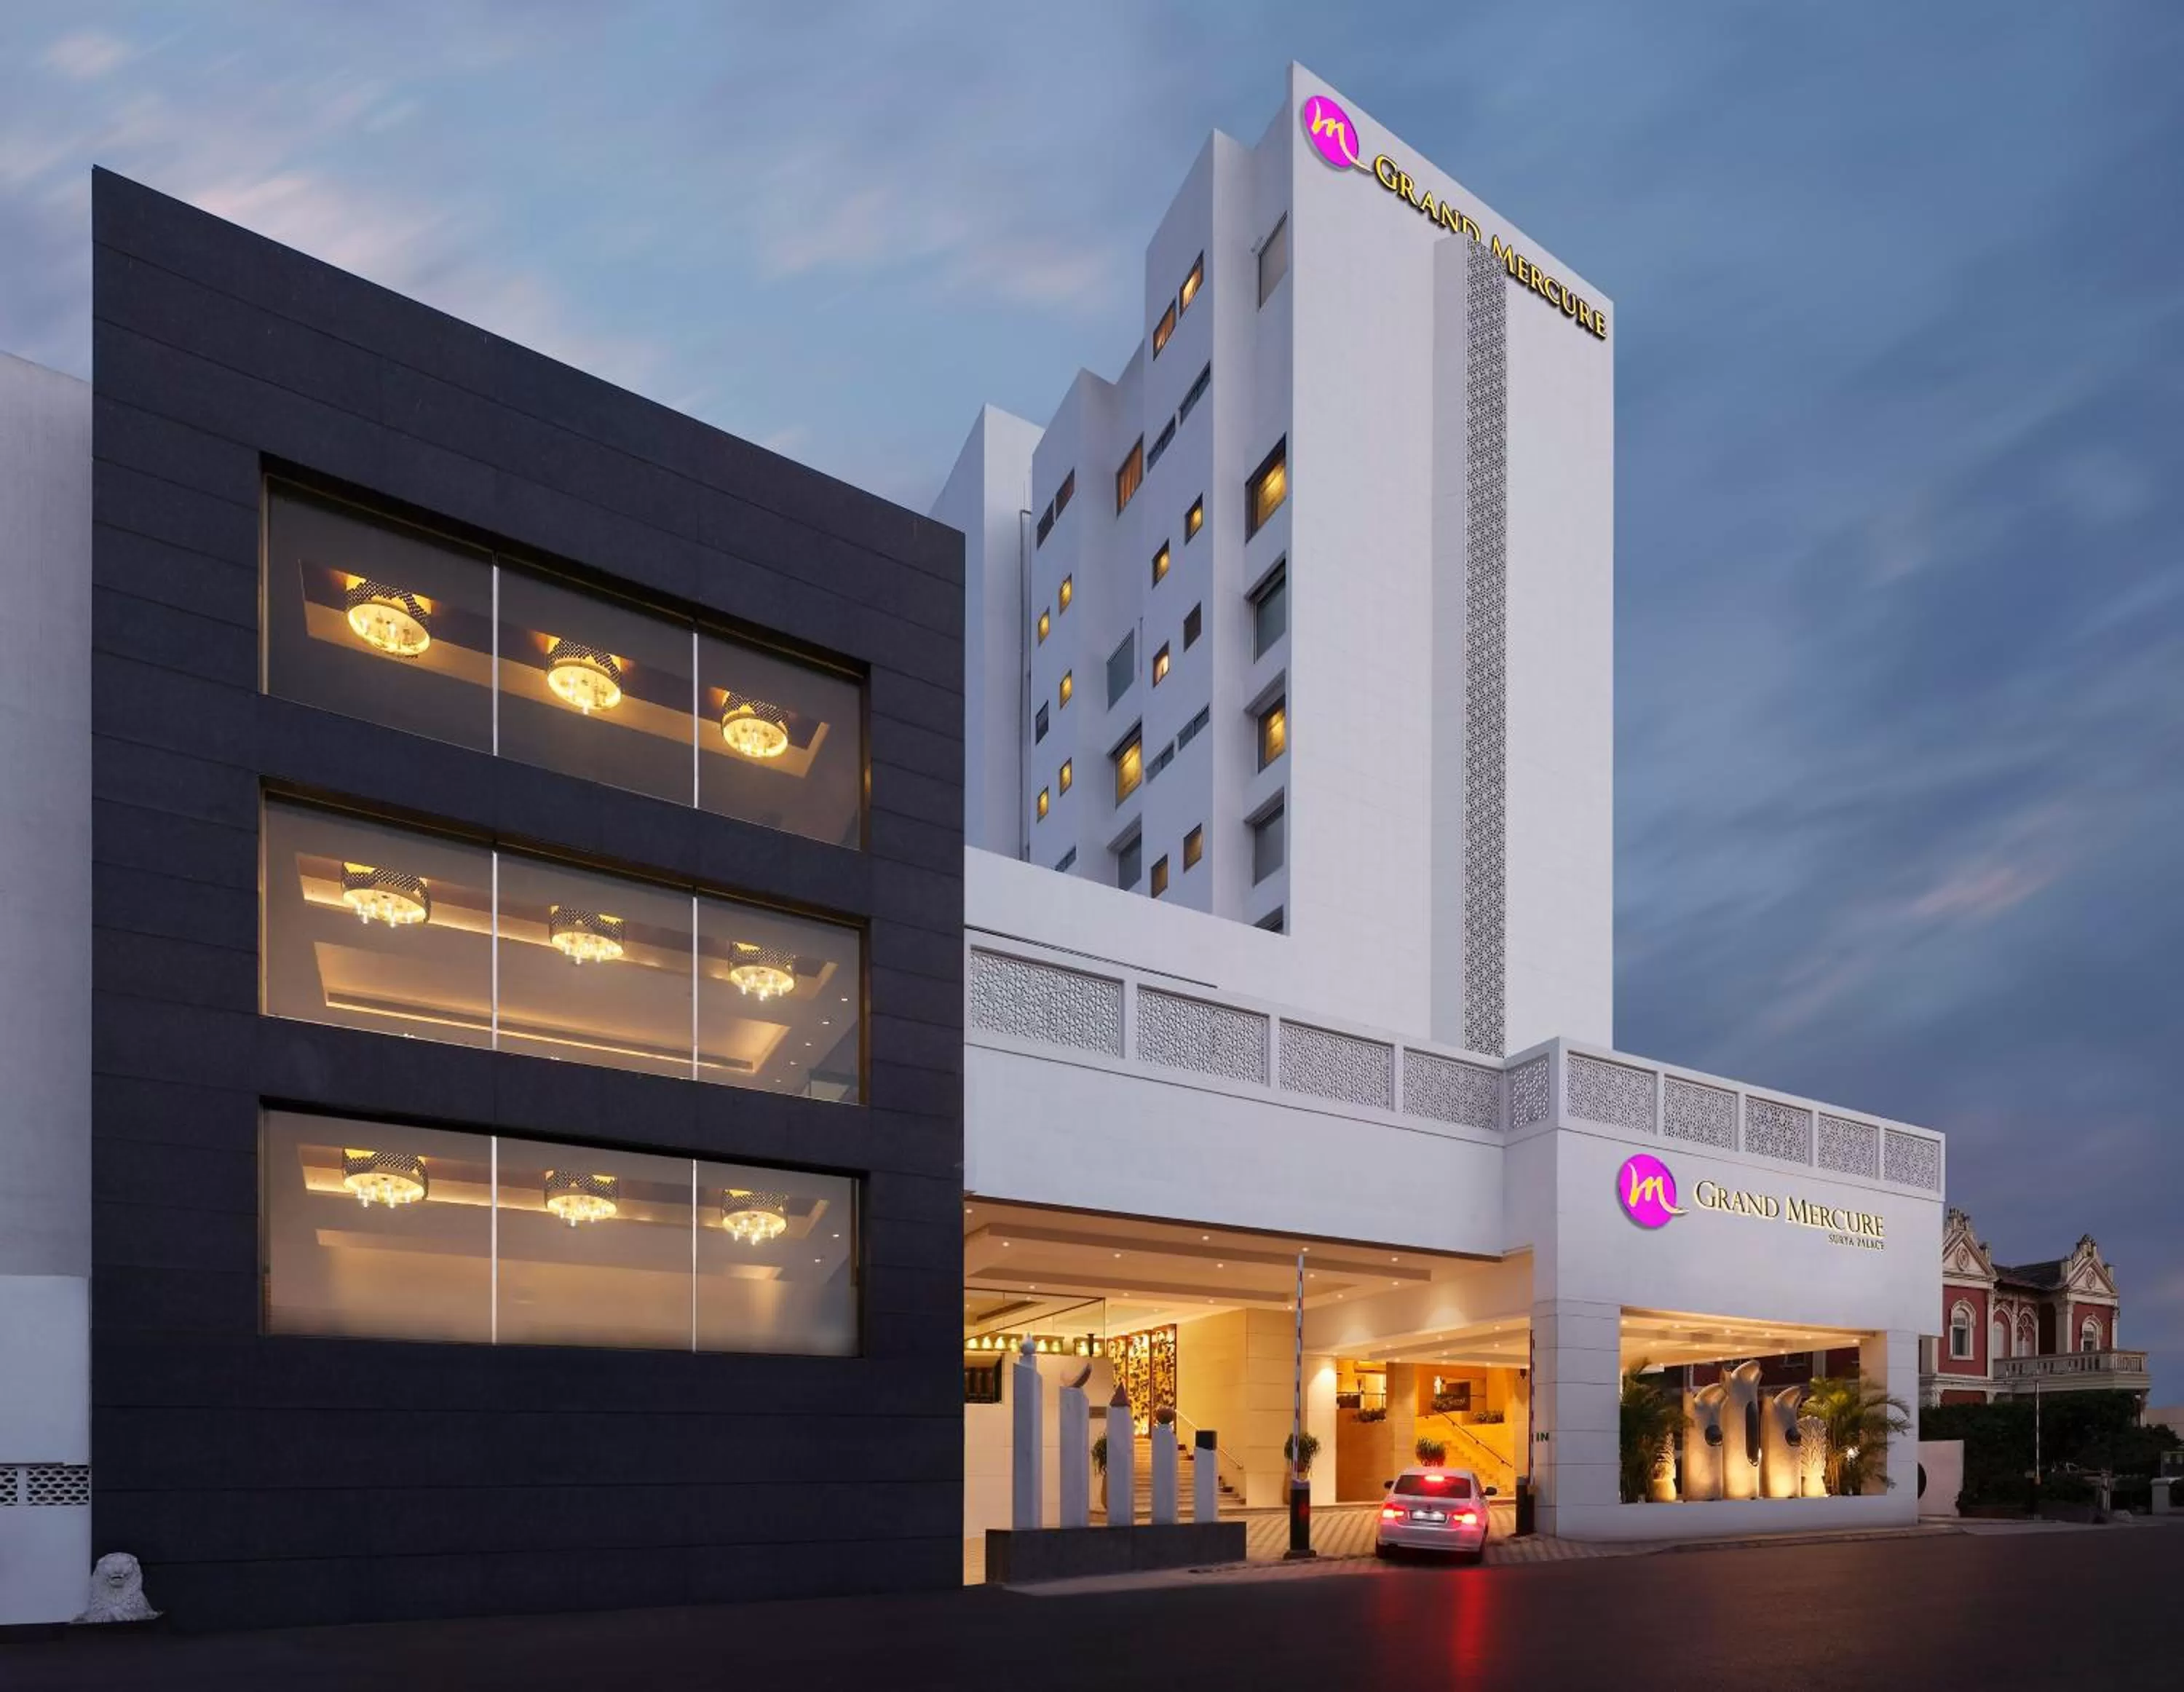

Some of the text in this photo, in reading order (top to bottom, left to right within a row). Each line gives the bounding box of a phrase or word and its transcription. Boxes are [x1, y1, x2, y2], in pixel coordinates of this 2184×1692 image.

[1491, 234, 1607, 339] MERCURE
[1694, 1179, 1887, 1238] GRAND MERCURE
[1536, 1432, 1550, 1442] IN
